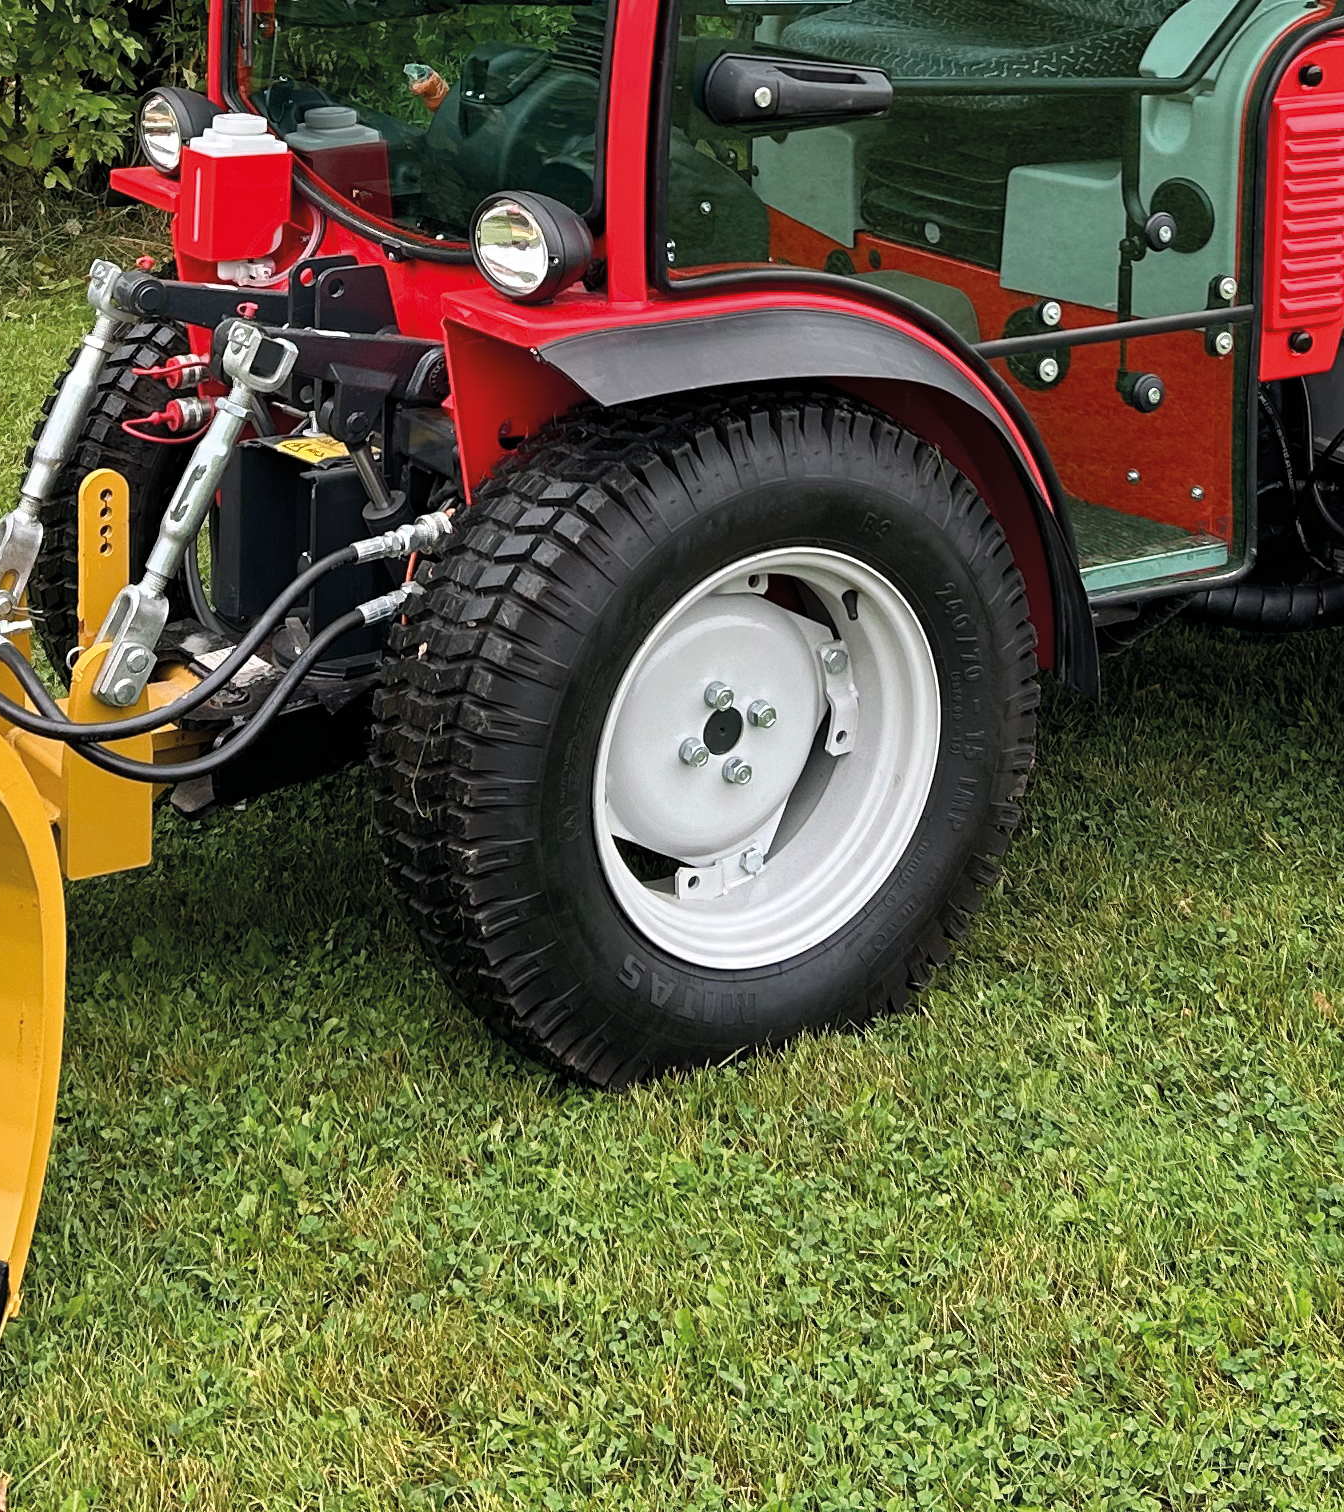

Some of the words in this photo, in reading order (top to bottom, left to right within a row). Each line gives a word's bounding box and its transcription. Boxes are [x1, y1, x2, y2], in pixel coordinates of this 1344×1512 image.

[935, 581, 984, 683] 240/70
[964, 729, 985, 761] 15
[946, 776, 979, 833] IMP
[614, 951, 757, 1026] MITAS
